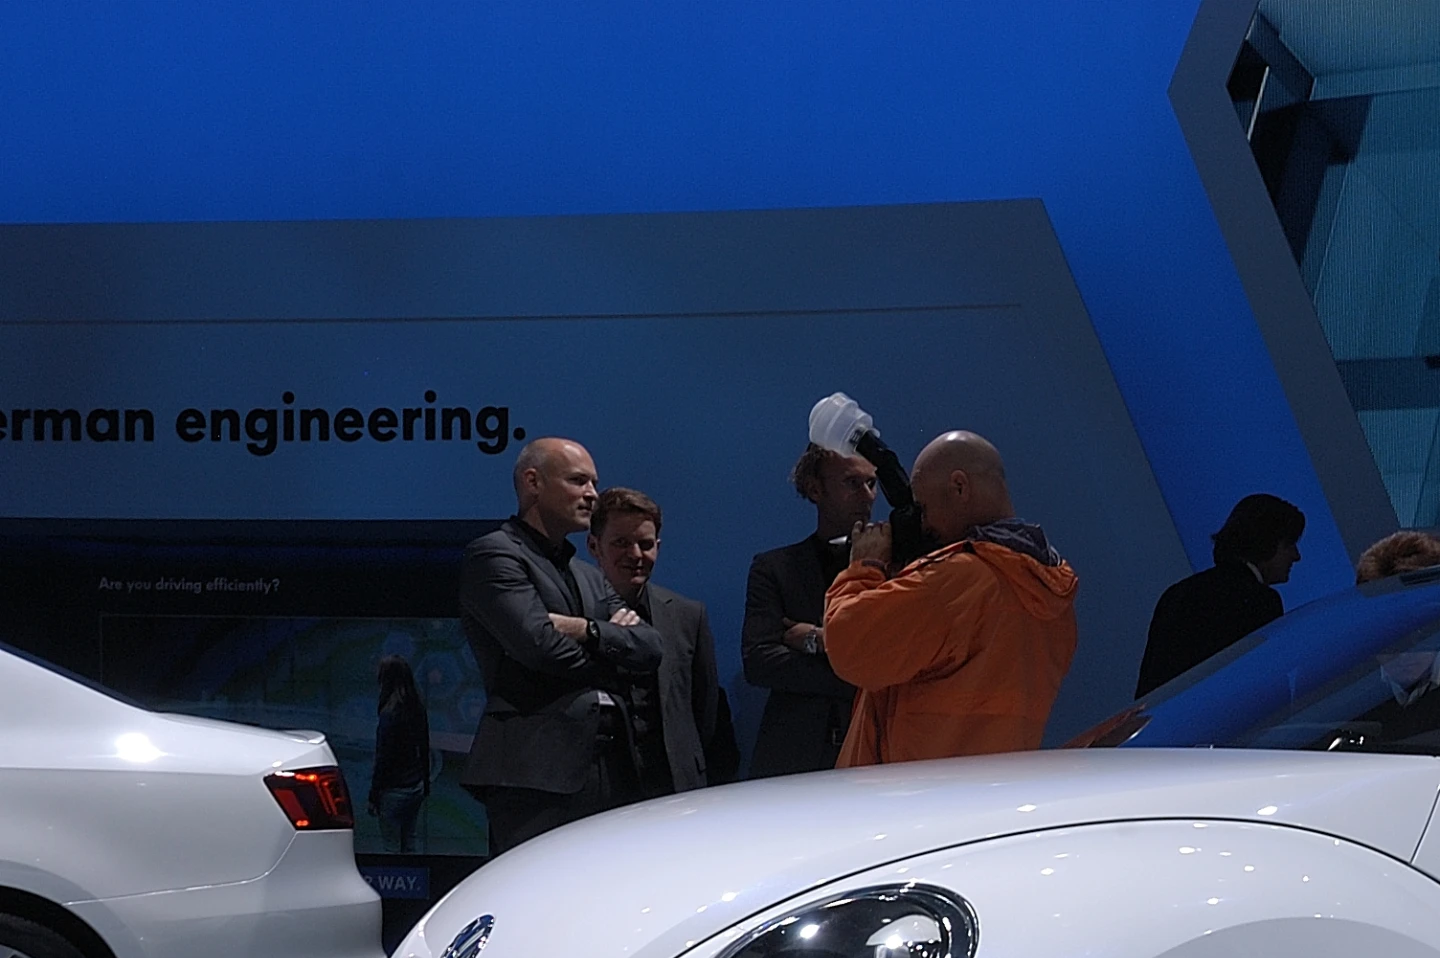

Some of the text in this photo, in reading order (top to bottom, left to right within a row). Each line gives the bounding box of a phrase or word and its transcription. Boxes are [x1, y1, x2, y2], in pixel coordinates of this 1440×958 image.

[0, 390, 527, 457] rman engineering.
[99, 577, 280, 594] Are you driving efficiently?
[378, 875, 420, 890] WAY.
